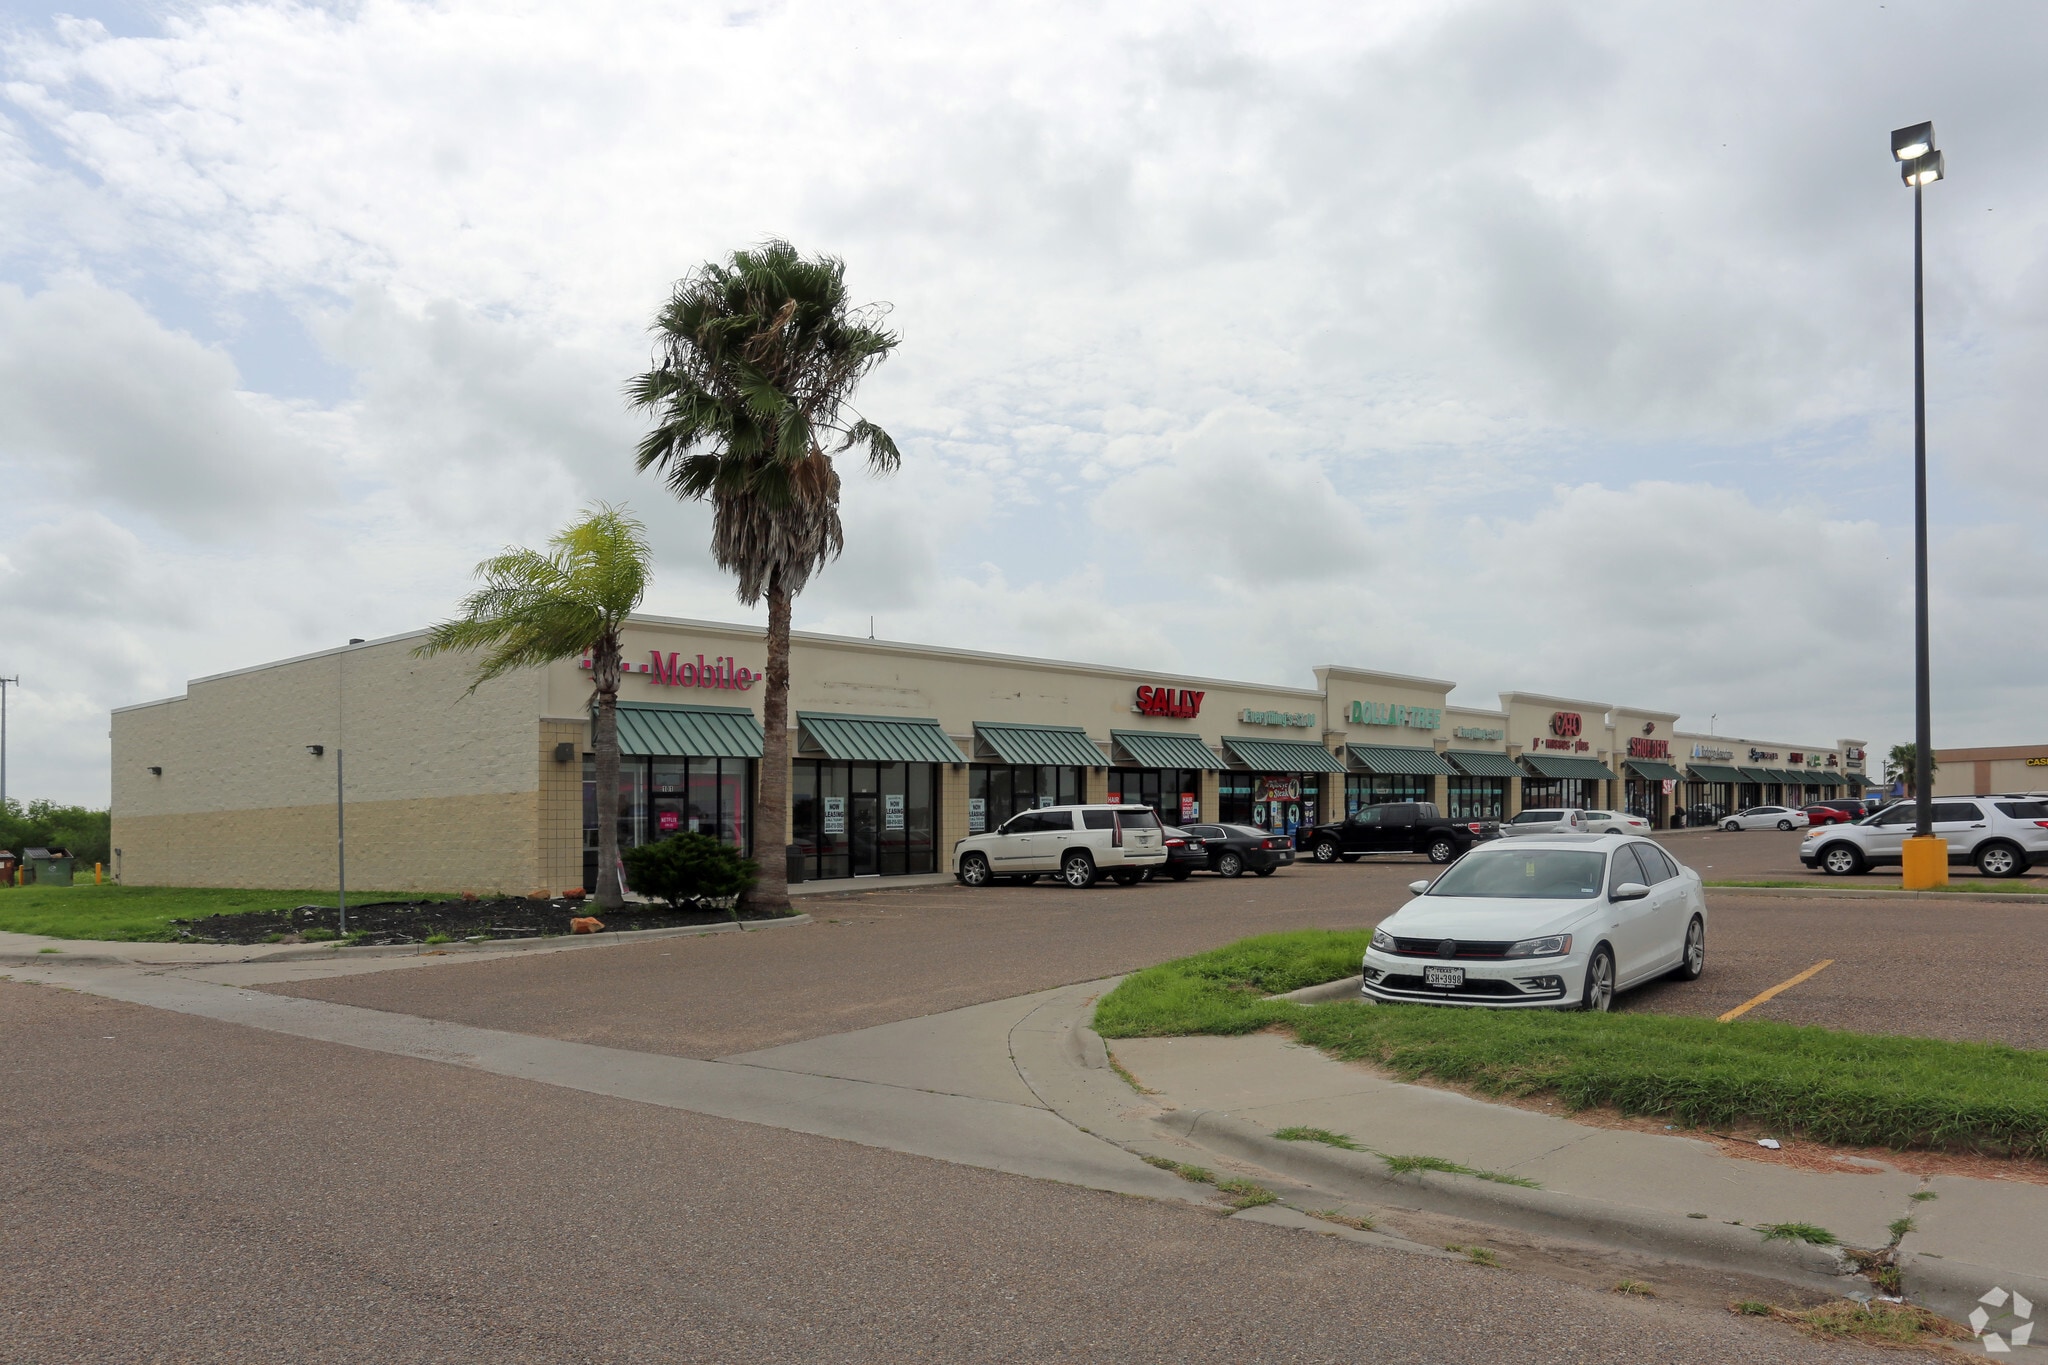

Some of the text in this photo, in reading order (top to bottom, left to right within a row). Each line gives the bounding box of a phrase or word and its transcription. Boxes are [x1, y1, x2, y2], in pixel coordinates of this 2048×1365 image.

[1136, 685, 1205, 712] SALLY
[1351, 700, 1441, 729] DOLLAR TREE
[1555, 711, 1582, 737] CATO
